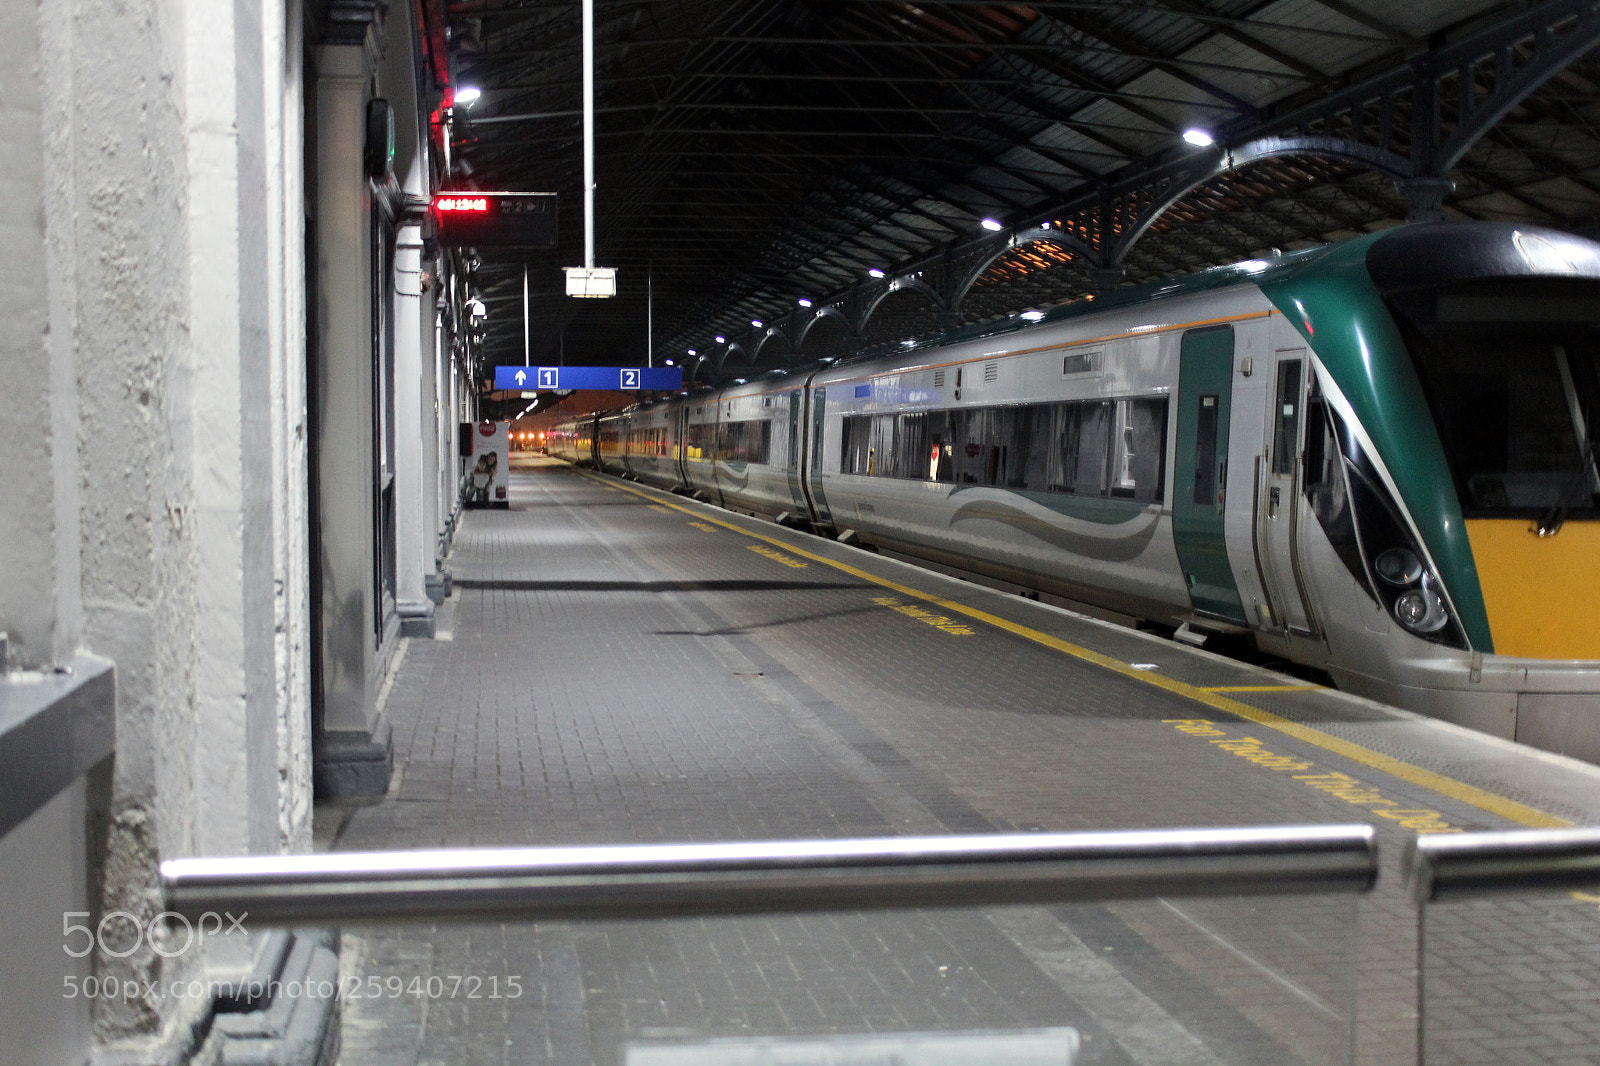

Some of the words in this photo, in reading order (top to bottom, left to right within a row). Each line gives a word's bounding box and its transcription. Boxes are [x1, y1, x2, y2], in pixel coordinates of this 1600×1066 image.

[544, 371, 552, 385] 1
[625, 372, 635, 385] 2
[1161, 719, 1227, 737] Fan
